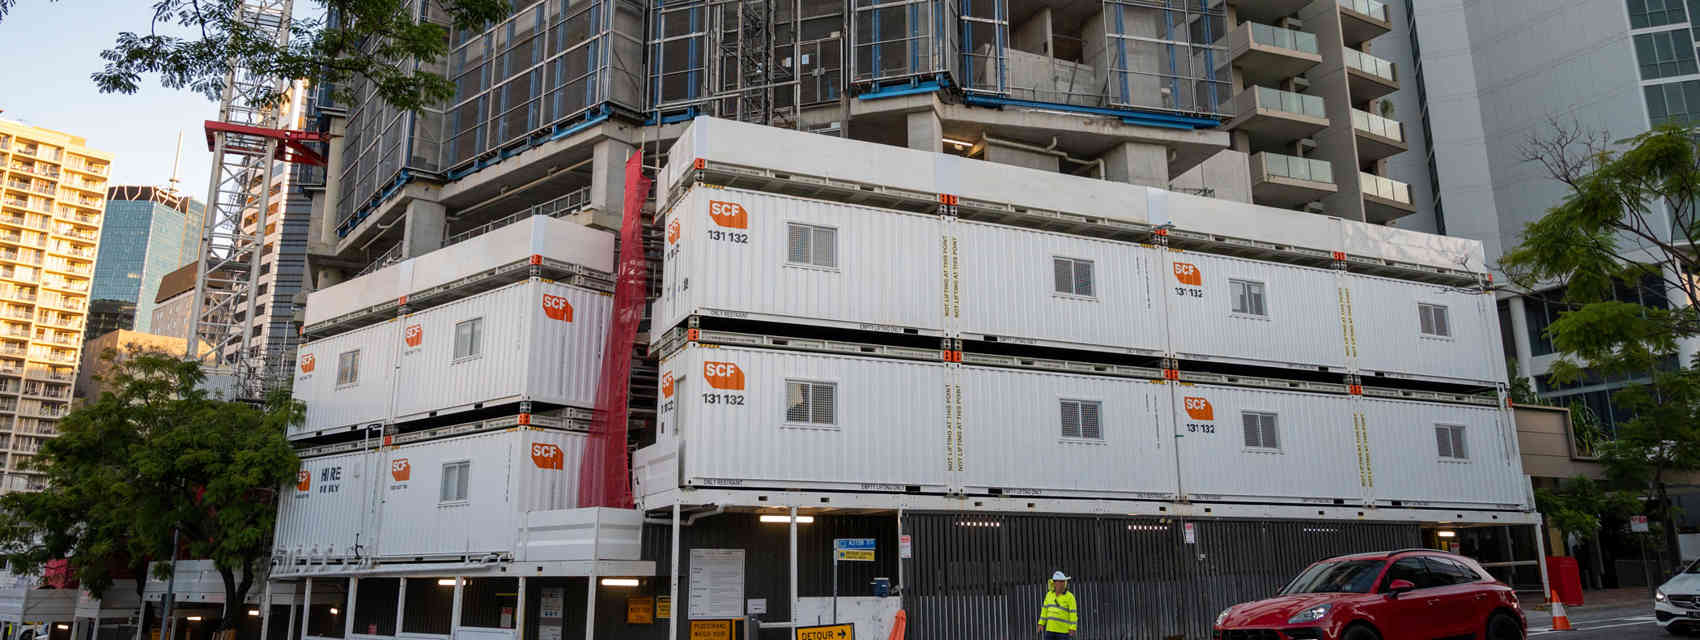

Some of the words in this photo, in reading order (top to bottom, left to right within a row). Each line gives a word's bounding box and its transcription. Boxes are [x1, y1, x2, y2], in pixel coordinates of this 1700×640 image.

[711, 202, 740, 216] SCF
[707, 230, 725, 241] 131
[728, 232, 749, 244] 132
[1175, 263, 1195, 274] SCF
[544, 296, 568, 310] SCF
[706, 364, 736, 376] SCF
[702, 393, 720, 404] 131
[723, 394, 744, 406] 132
[1186, 398, 1206, 410] SCF
[1186, 424, 1200, 432] 131
[1200, 424, 1215, 434] 132
[534, 446, 558, 456] SCF
[320, 466, 342, 482] HIRE
[802, 631, 834, 640] DETOUR
